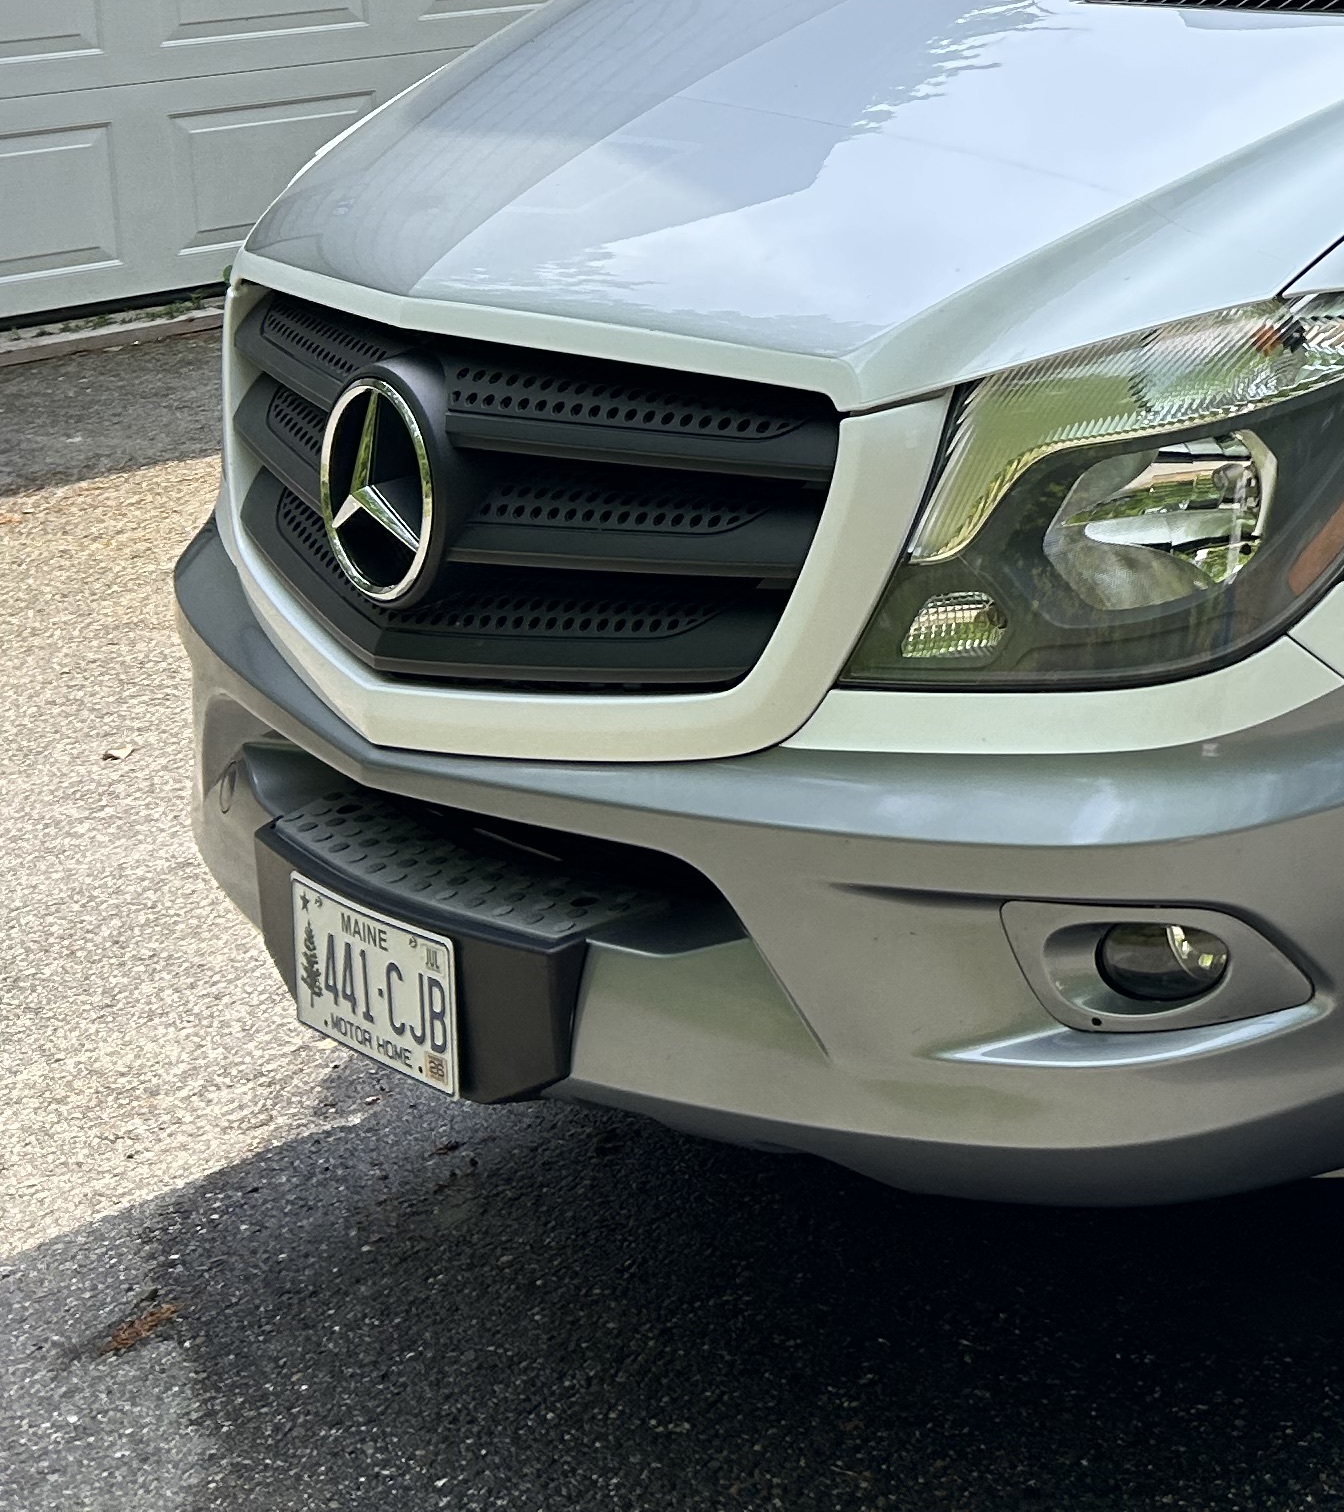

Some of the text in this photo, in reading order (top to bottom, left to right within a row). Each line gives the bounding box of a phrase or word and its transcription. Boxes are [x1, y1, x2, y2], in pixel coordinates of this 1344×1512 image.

[340, 912, 389, 952] MAINE
[330, 1013, 413, 1069] MOTOR HOME
